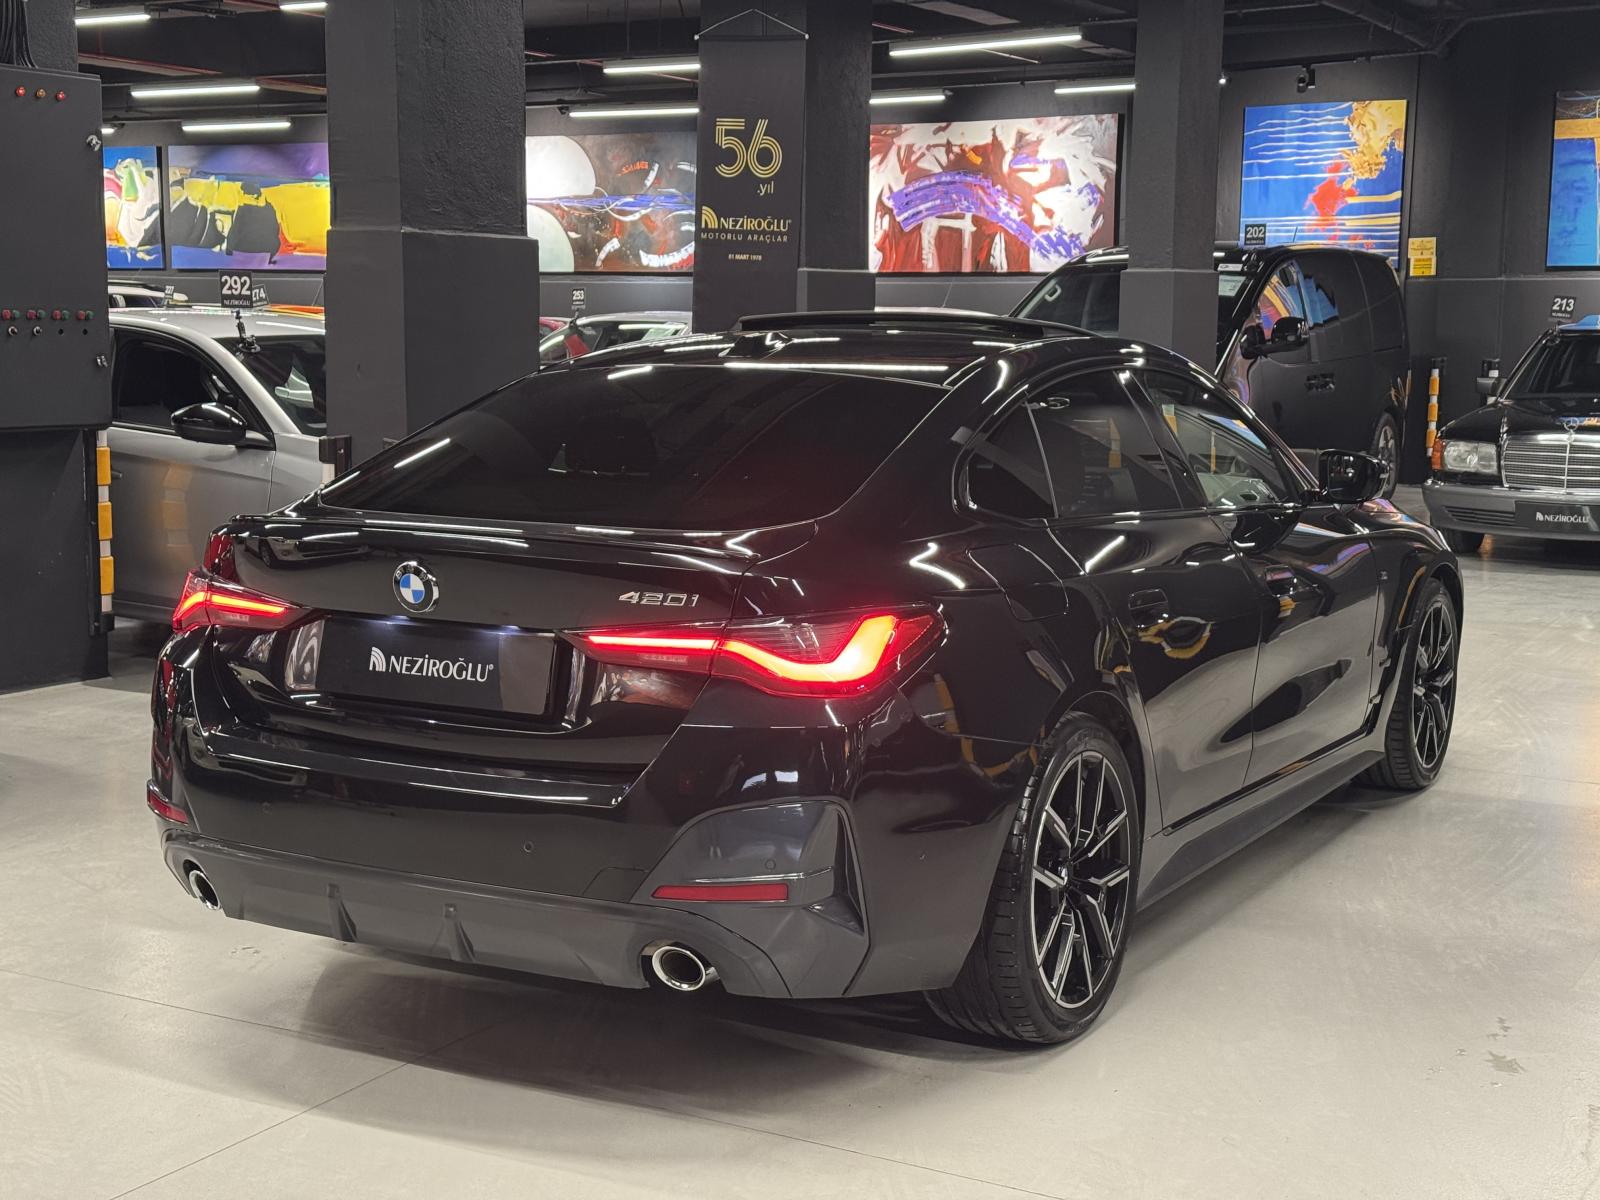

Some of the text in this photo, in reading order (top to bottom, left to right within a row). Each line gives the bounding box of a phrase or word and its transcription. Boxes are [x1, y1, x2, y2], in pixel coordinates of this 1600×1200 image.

[715, 118, 783, 178] 56
[720, 215, 789, 232] NEZİROĞLU
[701, 232, 788, 244] MOTORLU ARAÇLAR
[1246, 226, 1265, 238] 202
[221, 275, 251, 295] 292
[1552, 297, 1575, 311] 213
